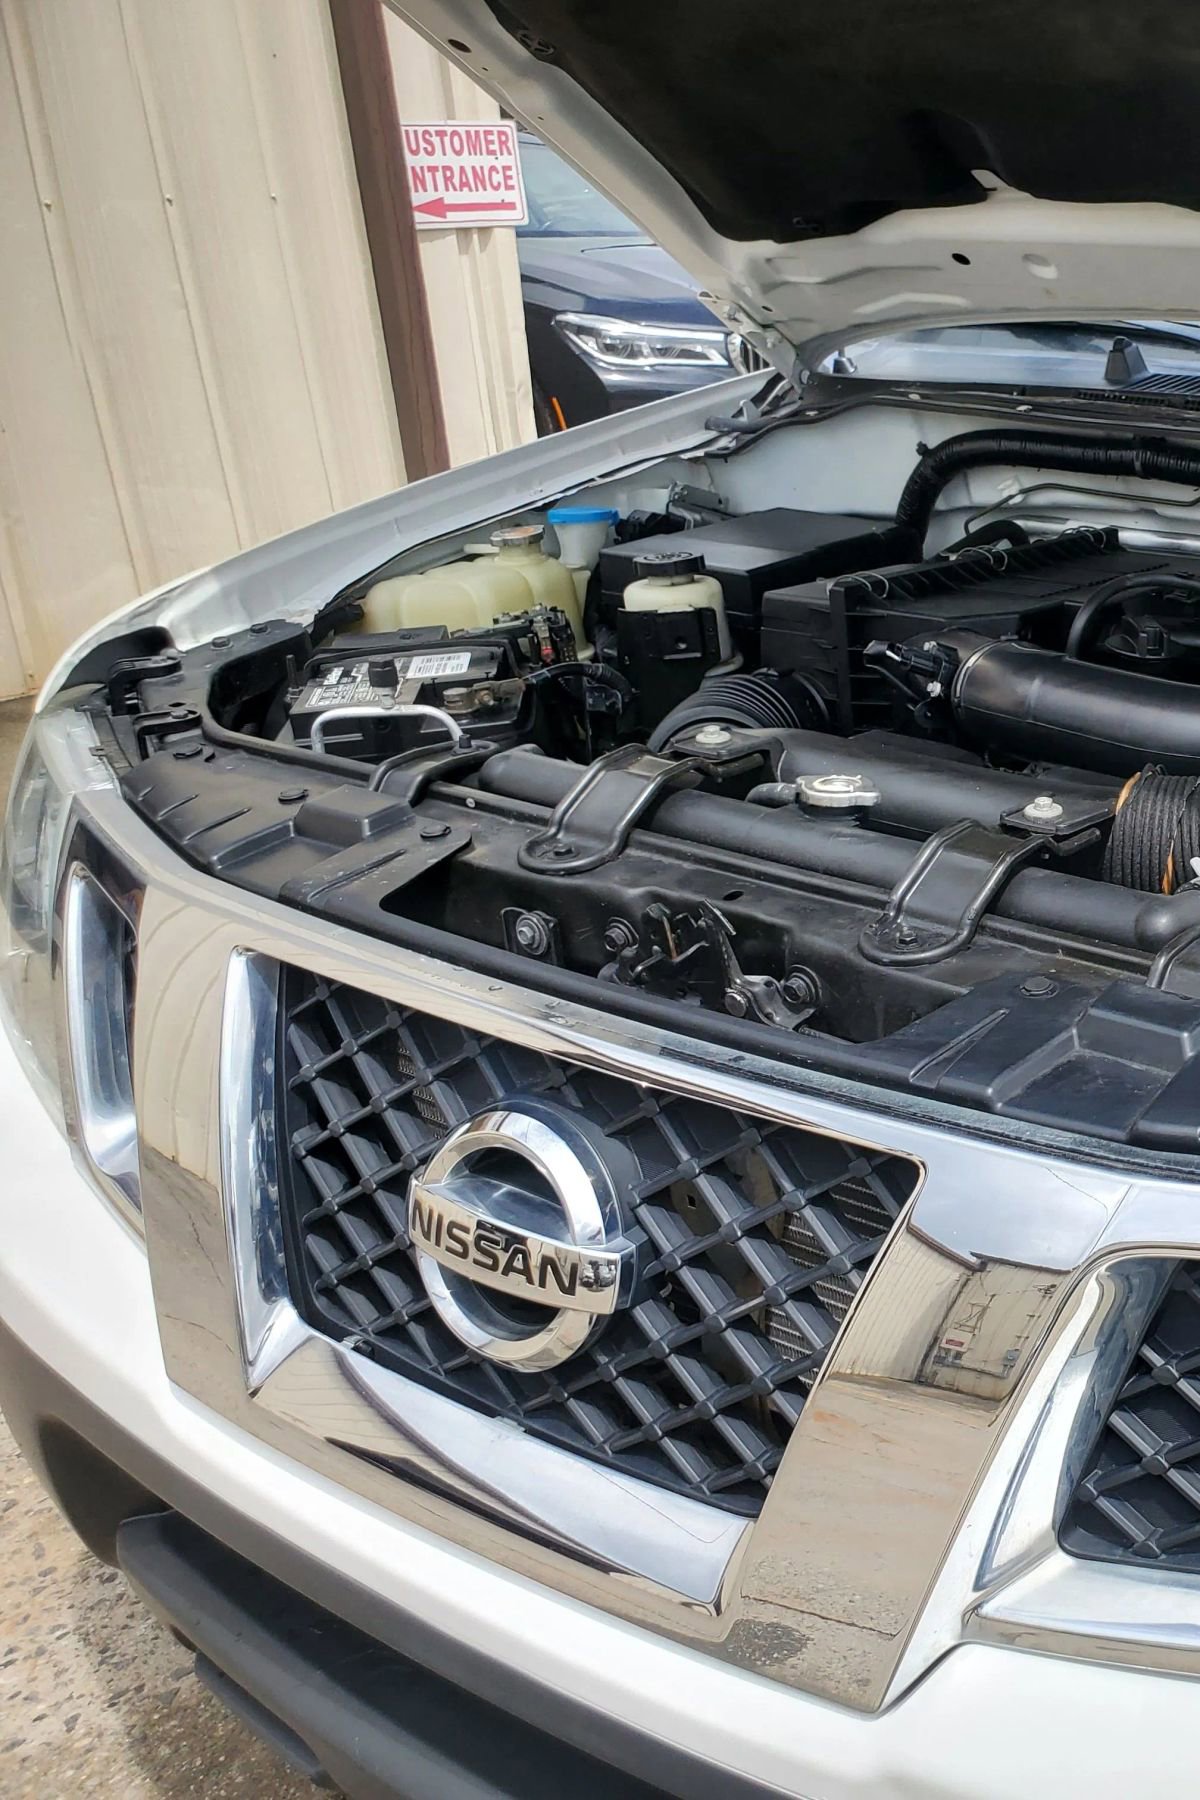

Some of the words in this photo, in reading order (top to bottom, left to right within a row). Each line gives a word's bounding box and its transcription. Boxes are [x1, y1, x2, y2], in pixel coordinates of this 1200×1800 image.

[404, 129, 513, 157] USTOMER
[410, 164, 516, 193] NTRANCE
[411, 1202, 579, 1297] NISSAN
